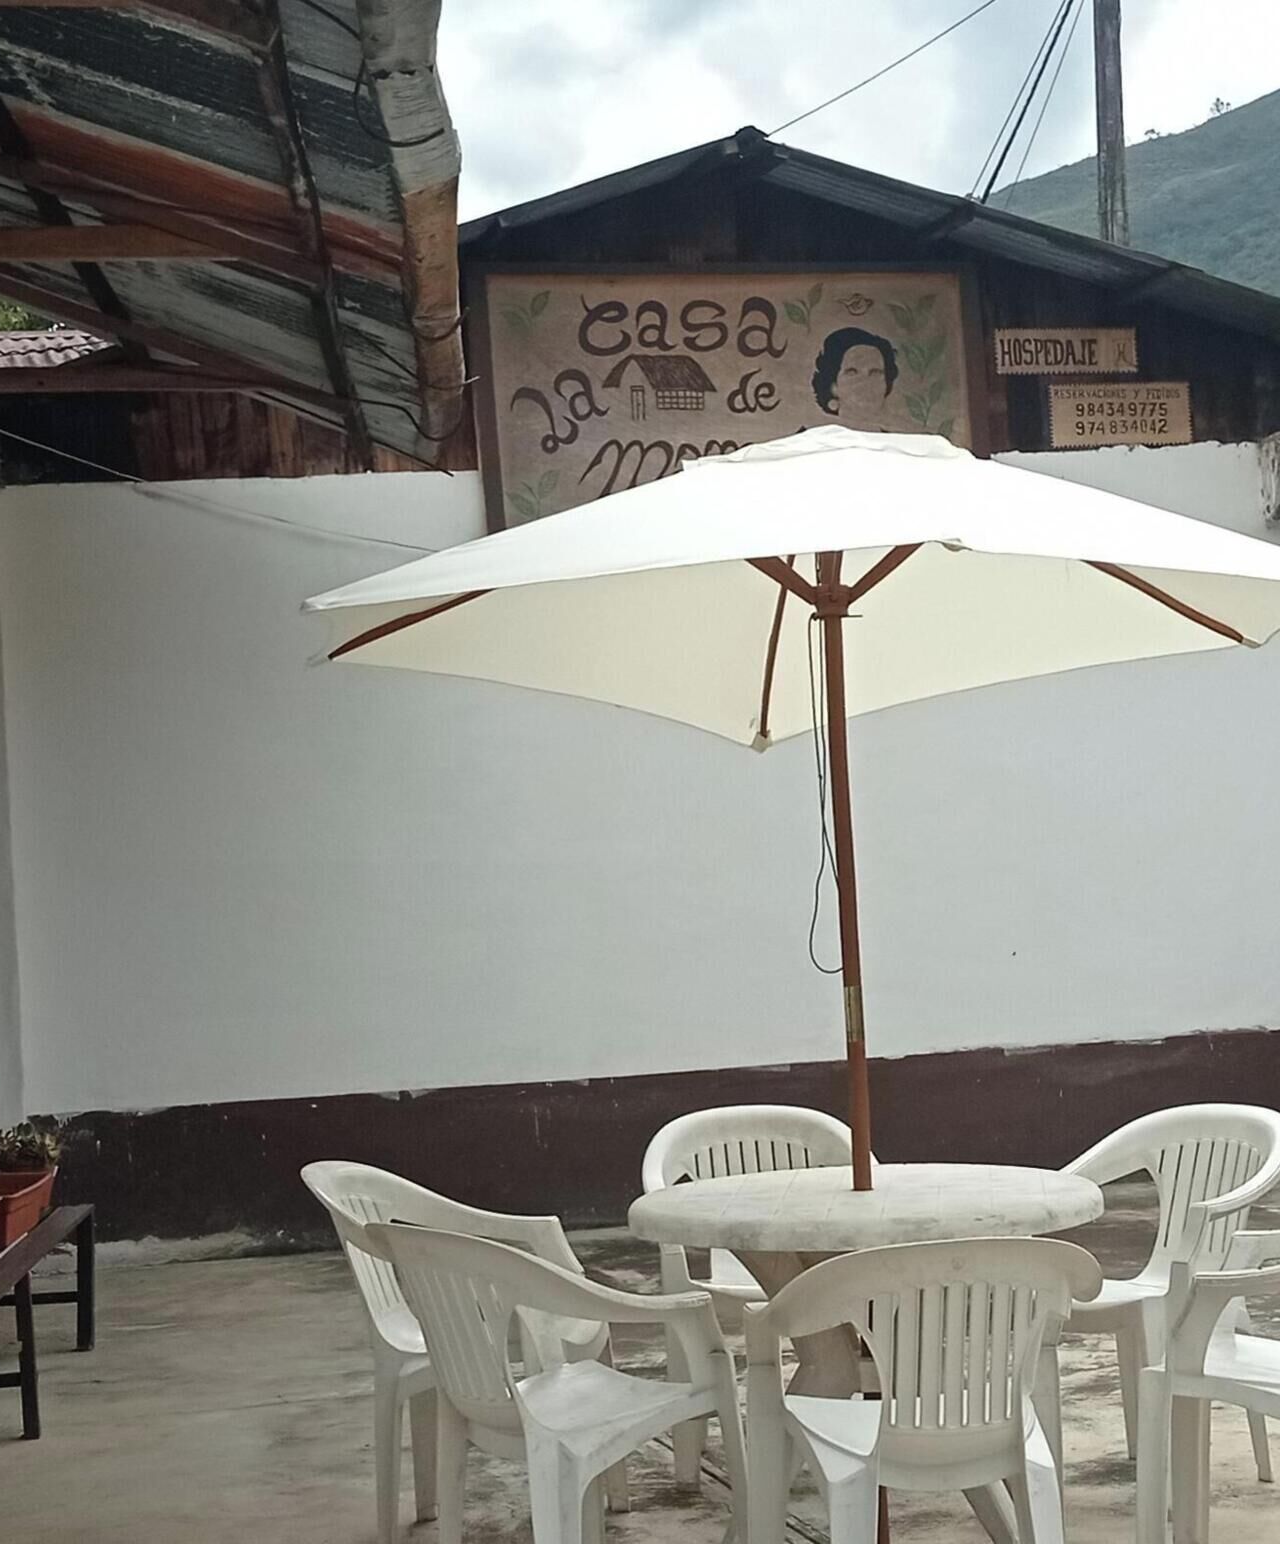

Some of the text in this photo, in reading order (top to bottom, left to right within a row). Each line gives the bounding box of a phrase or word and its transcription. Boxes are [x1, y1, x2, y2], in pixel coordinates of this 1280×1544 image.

[1000, 338, 1098, 367] HOSPEDAJE
[1053, 389, 1126, 399] RESERVACIONES
[510, 368, 781, 454] La de
[1075, 402, 1168, 417] 984349775
